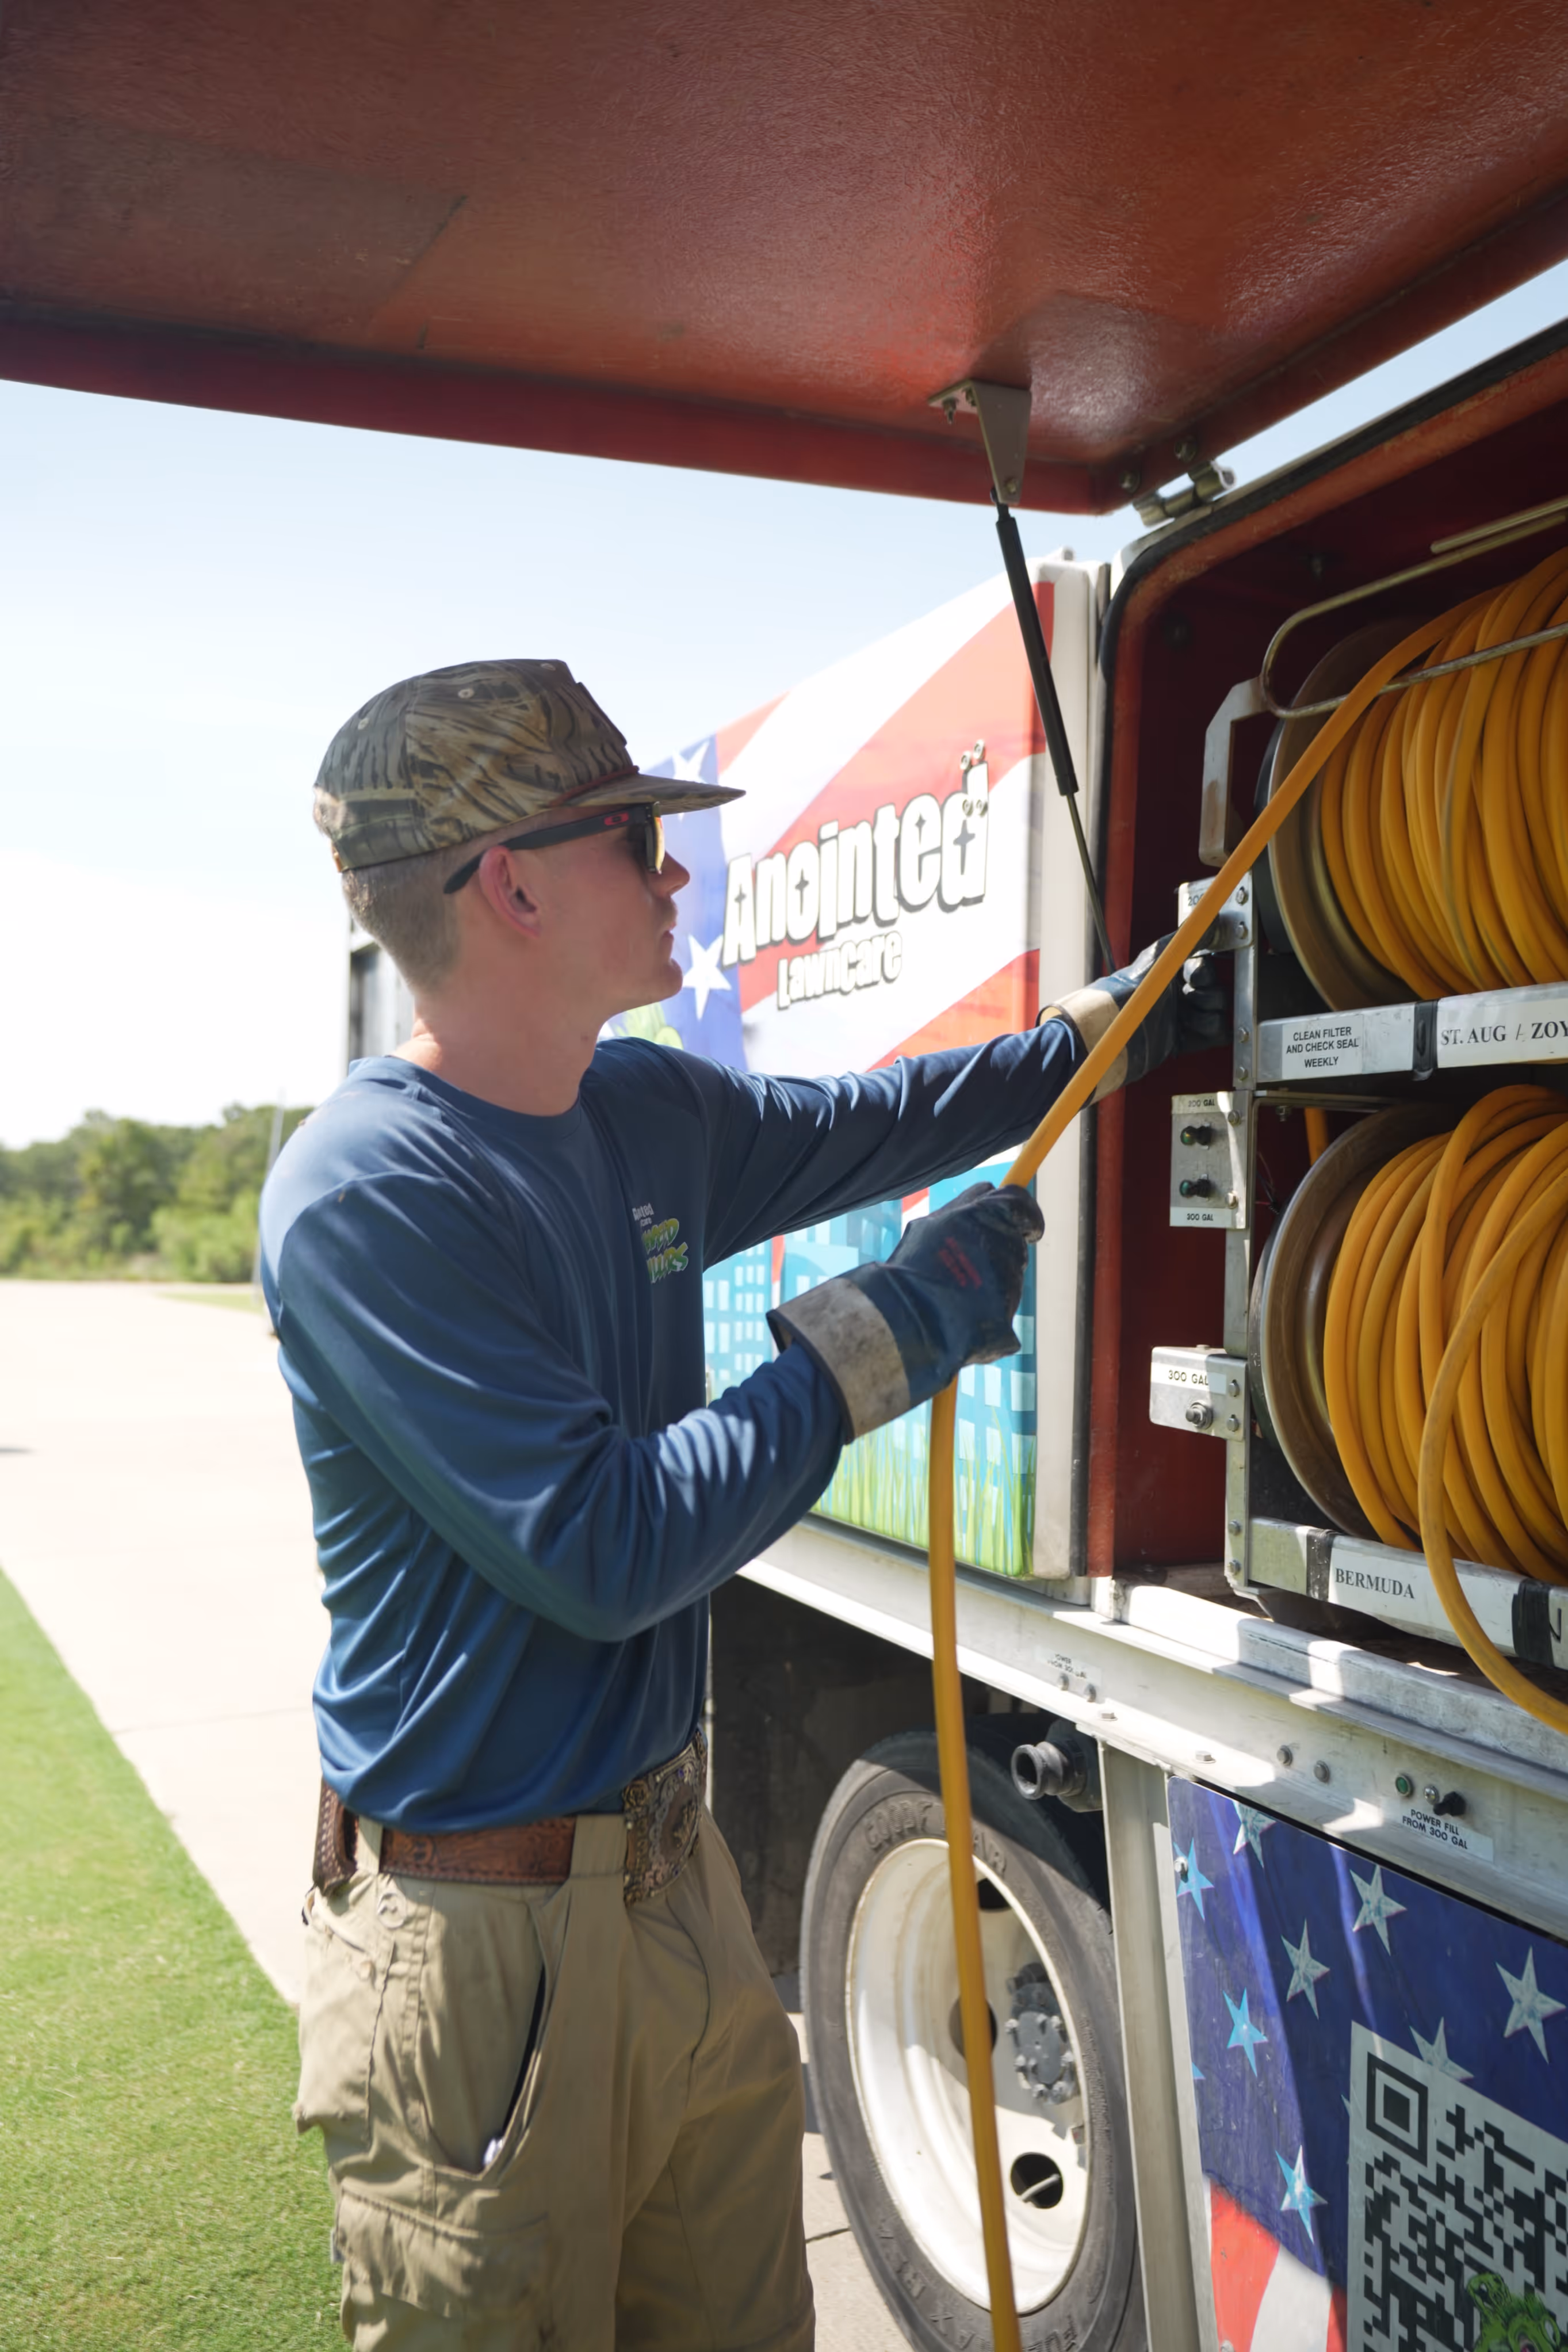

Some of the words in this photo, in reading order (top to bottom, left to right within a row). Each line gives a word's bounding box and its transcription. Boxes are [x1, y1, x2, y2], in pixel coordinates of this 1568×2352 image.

[722, 757, 989, 969] Anointed
[1293, 1029, 1321, 1041] CLEAN
[1323, 1026, 1352, 1038] FILTER
[1440, 1029, 1464, 1045] ST.
[1467, 1025, 1507, 1044] AUG
[1286, 1043, 1303, 1054] AND
[1306, 1040, 1334, 1052] CHECK
[1336, 1038, 1359, 1049] SEAL
[1304, 1056, 1339, 1068] WEEKLY
[1203, 1098, 1215, 1107] GAL
[1186, 1213, 1200, 1221] 300
[1202, 1213, 1214, 1221] GAL
[1168, 1369, 1187, 1382] 300
[1191, 1373, 1209, 1386] GAL
[1335, 1567, 1415, 1599] BERMUDA
[1410, 1809, 1441, 1828] POWER
[1444, 1822, 1460, 1836] FILL
[1402, 1816, 1427, 1833] FROM
[1429, 1827, 1448, 1841] 300
[1451, 1836, 1468, 1850] GAL
